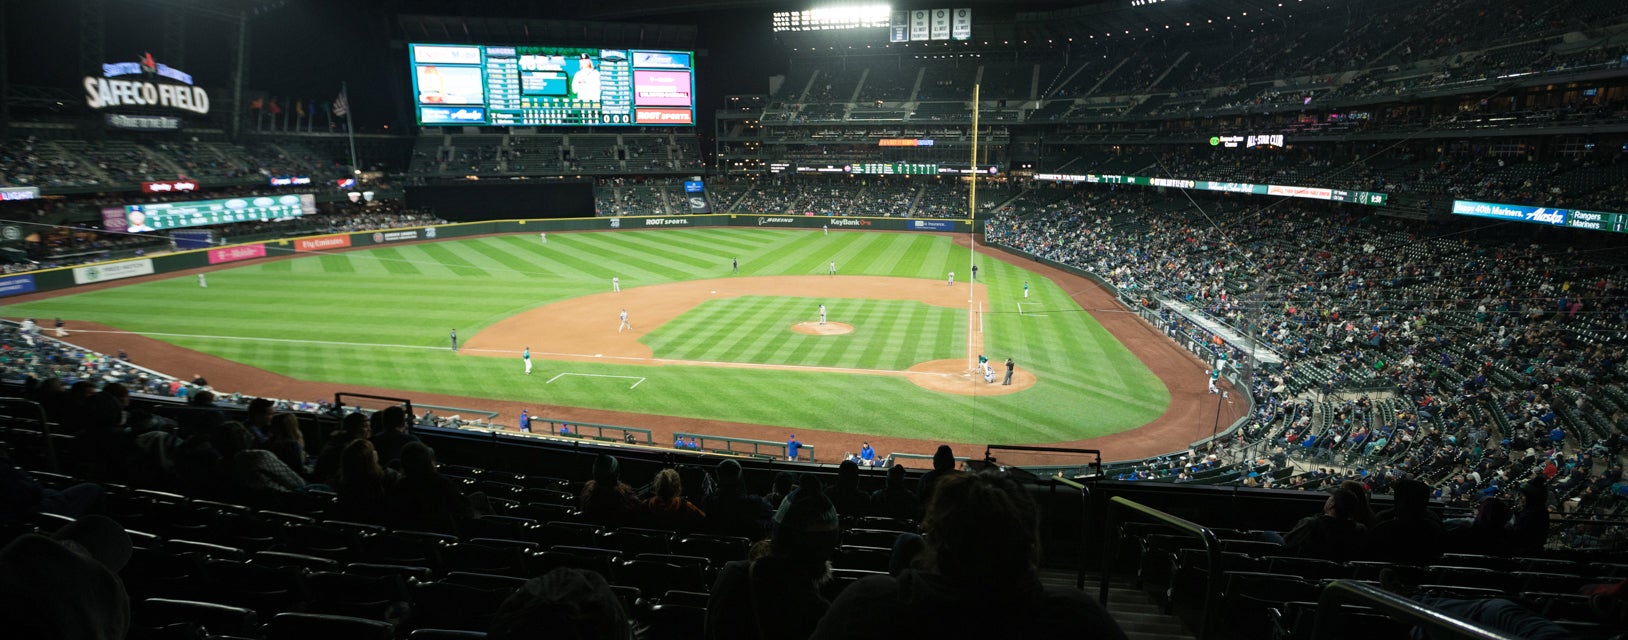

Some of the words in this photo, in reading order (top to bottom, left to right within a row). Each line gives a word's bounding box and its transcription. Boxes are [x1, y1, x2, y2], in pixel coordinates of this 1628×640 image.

[83, 76, 158, 109] SAFECO
[157, 83, 210, 114] FIELD
[603, 114, 610, 123] 0
[613, 114, 620, 123] 0
[622, 114, 629, 123] 0
[637, 111, 661, 120] ROOT
[1270, 134, 1284, 148] CLUB
[1454, 202, 1475, 214] Happy
[1475, 204, 1491, 214] 40th
[831, 218, 860, 226] KeyBank
[1573, 211, 1601, 221] Rangers
[1618, 214, 1623, 222] 1
[1572, 220, 1600, 229] Mariners
[1616, 223, 1621, 231] 1
[302, 240, 315, 248] Fly
[315, 238, 344, 247] Emirates
